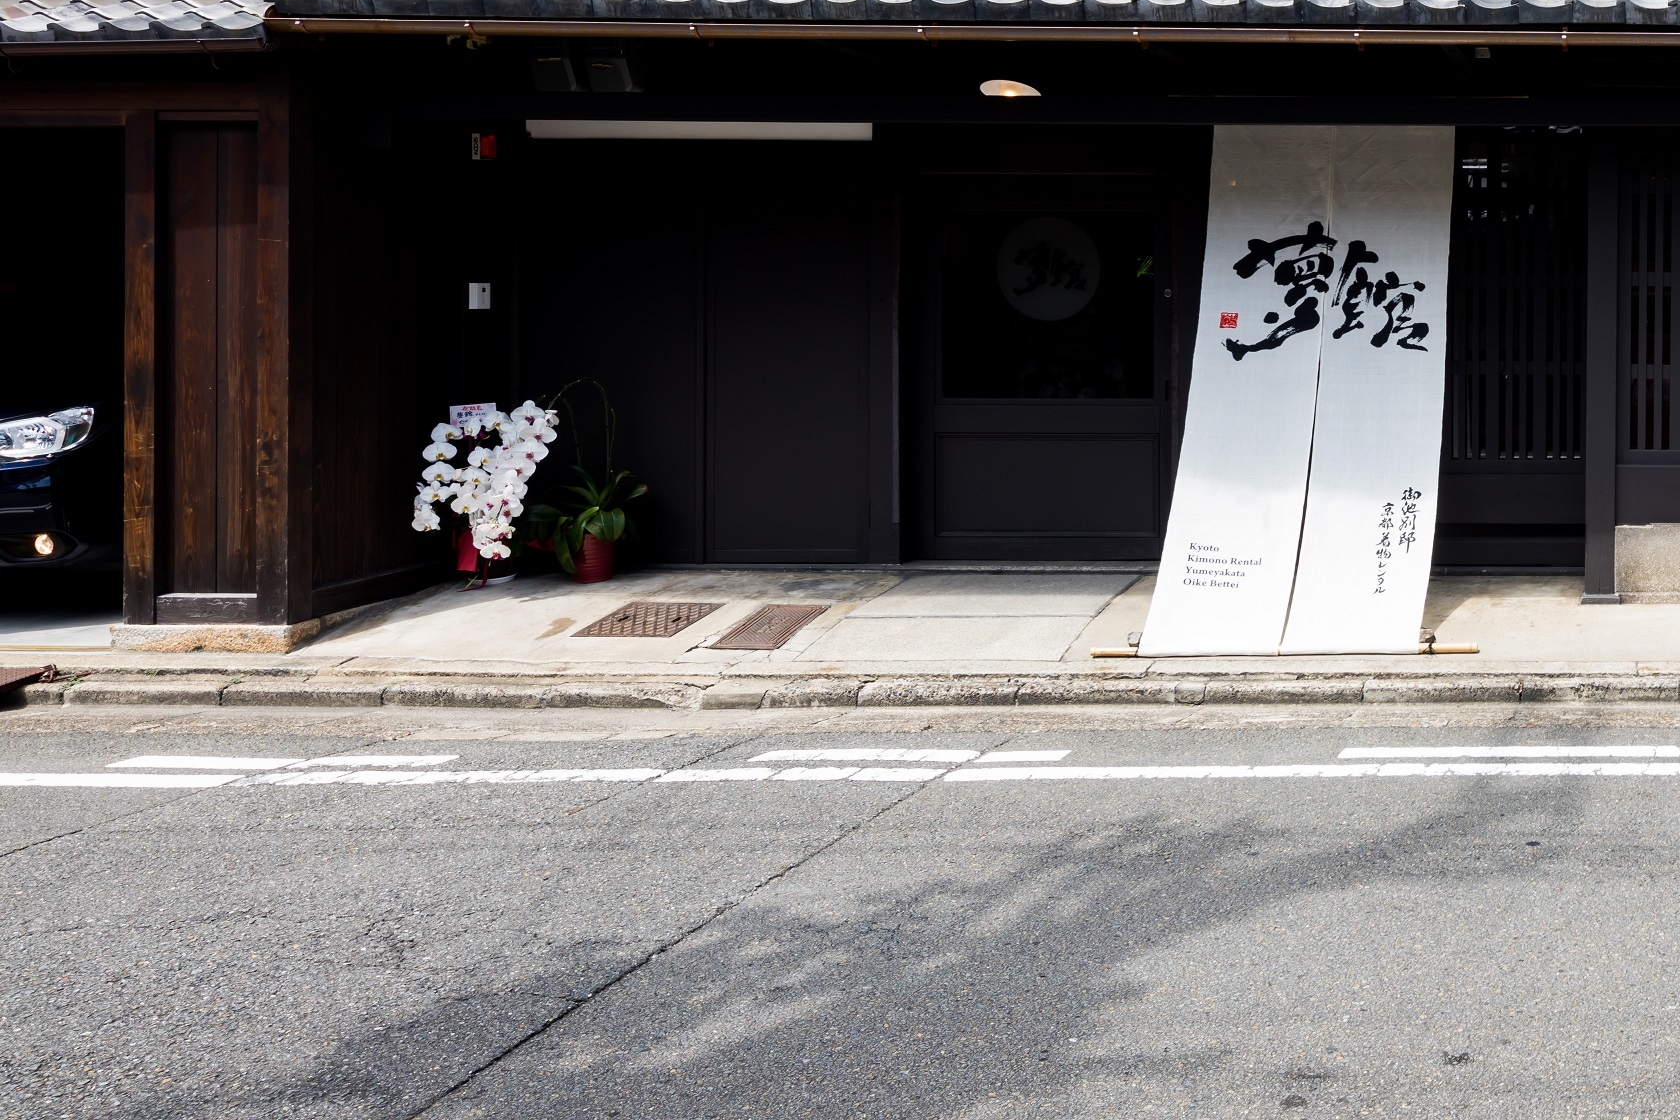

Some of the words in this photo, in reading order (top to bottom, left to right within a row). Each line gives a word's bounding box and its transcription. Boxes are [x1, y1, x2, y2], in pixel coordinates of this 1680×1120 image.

[1398, 486, 1422, 554] 御池別邸
[1189, 542, 1220, 553] Kyoto
[1373, 502, 1395, 595] 京都着物レンタル
[1187, 554, 1228, 565] Kimono
[1230, 557, 1262, 566] Rental
[1185, 566, 1246, 578] Yumeyakata
[1183, 577, 1207, 587] Oike
[1209, 579, 1240, 589] Bettei
